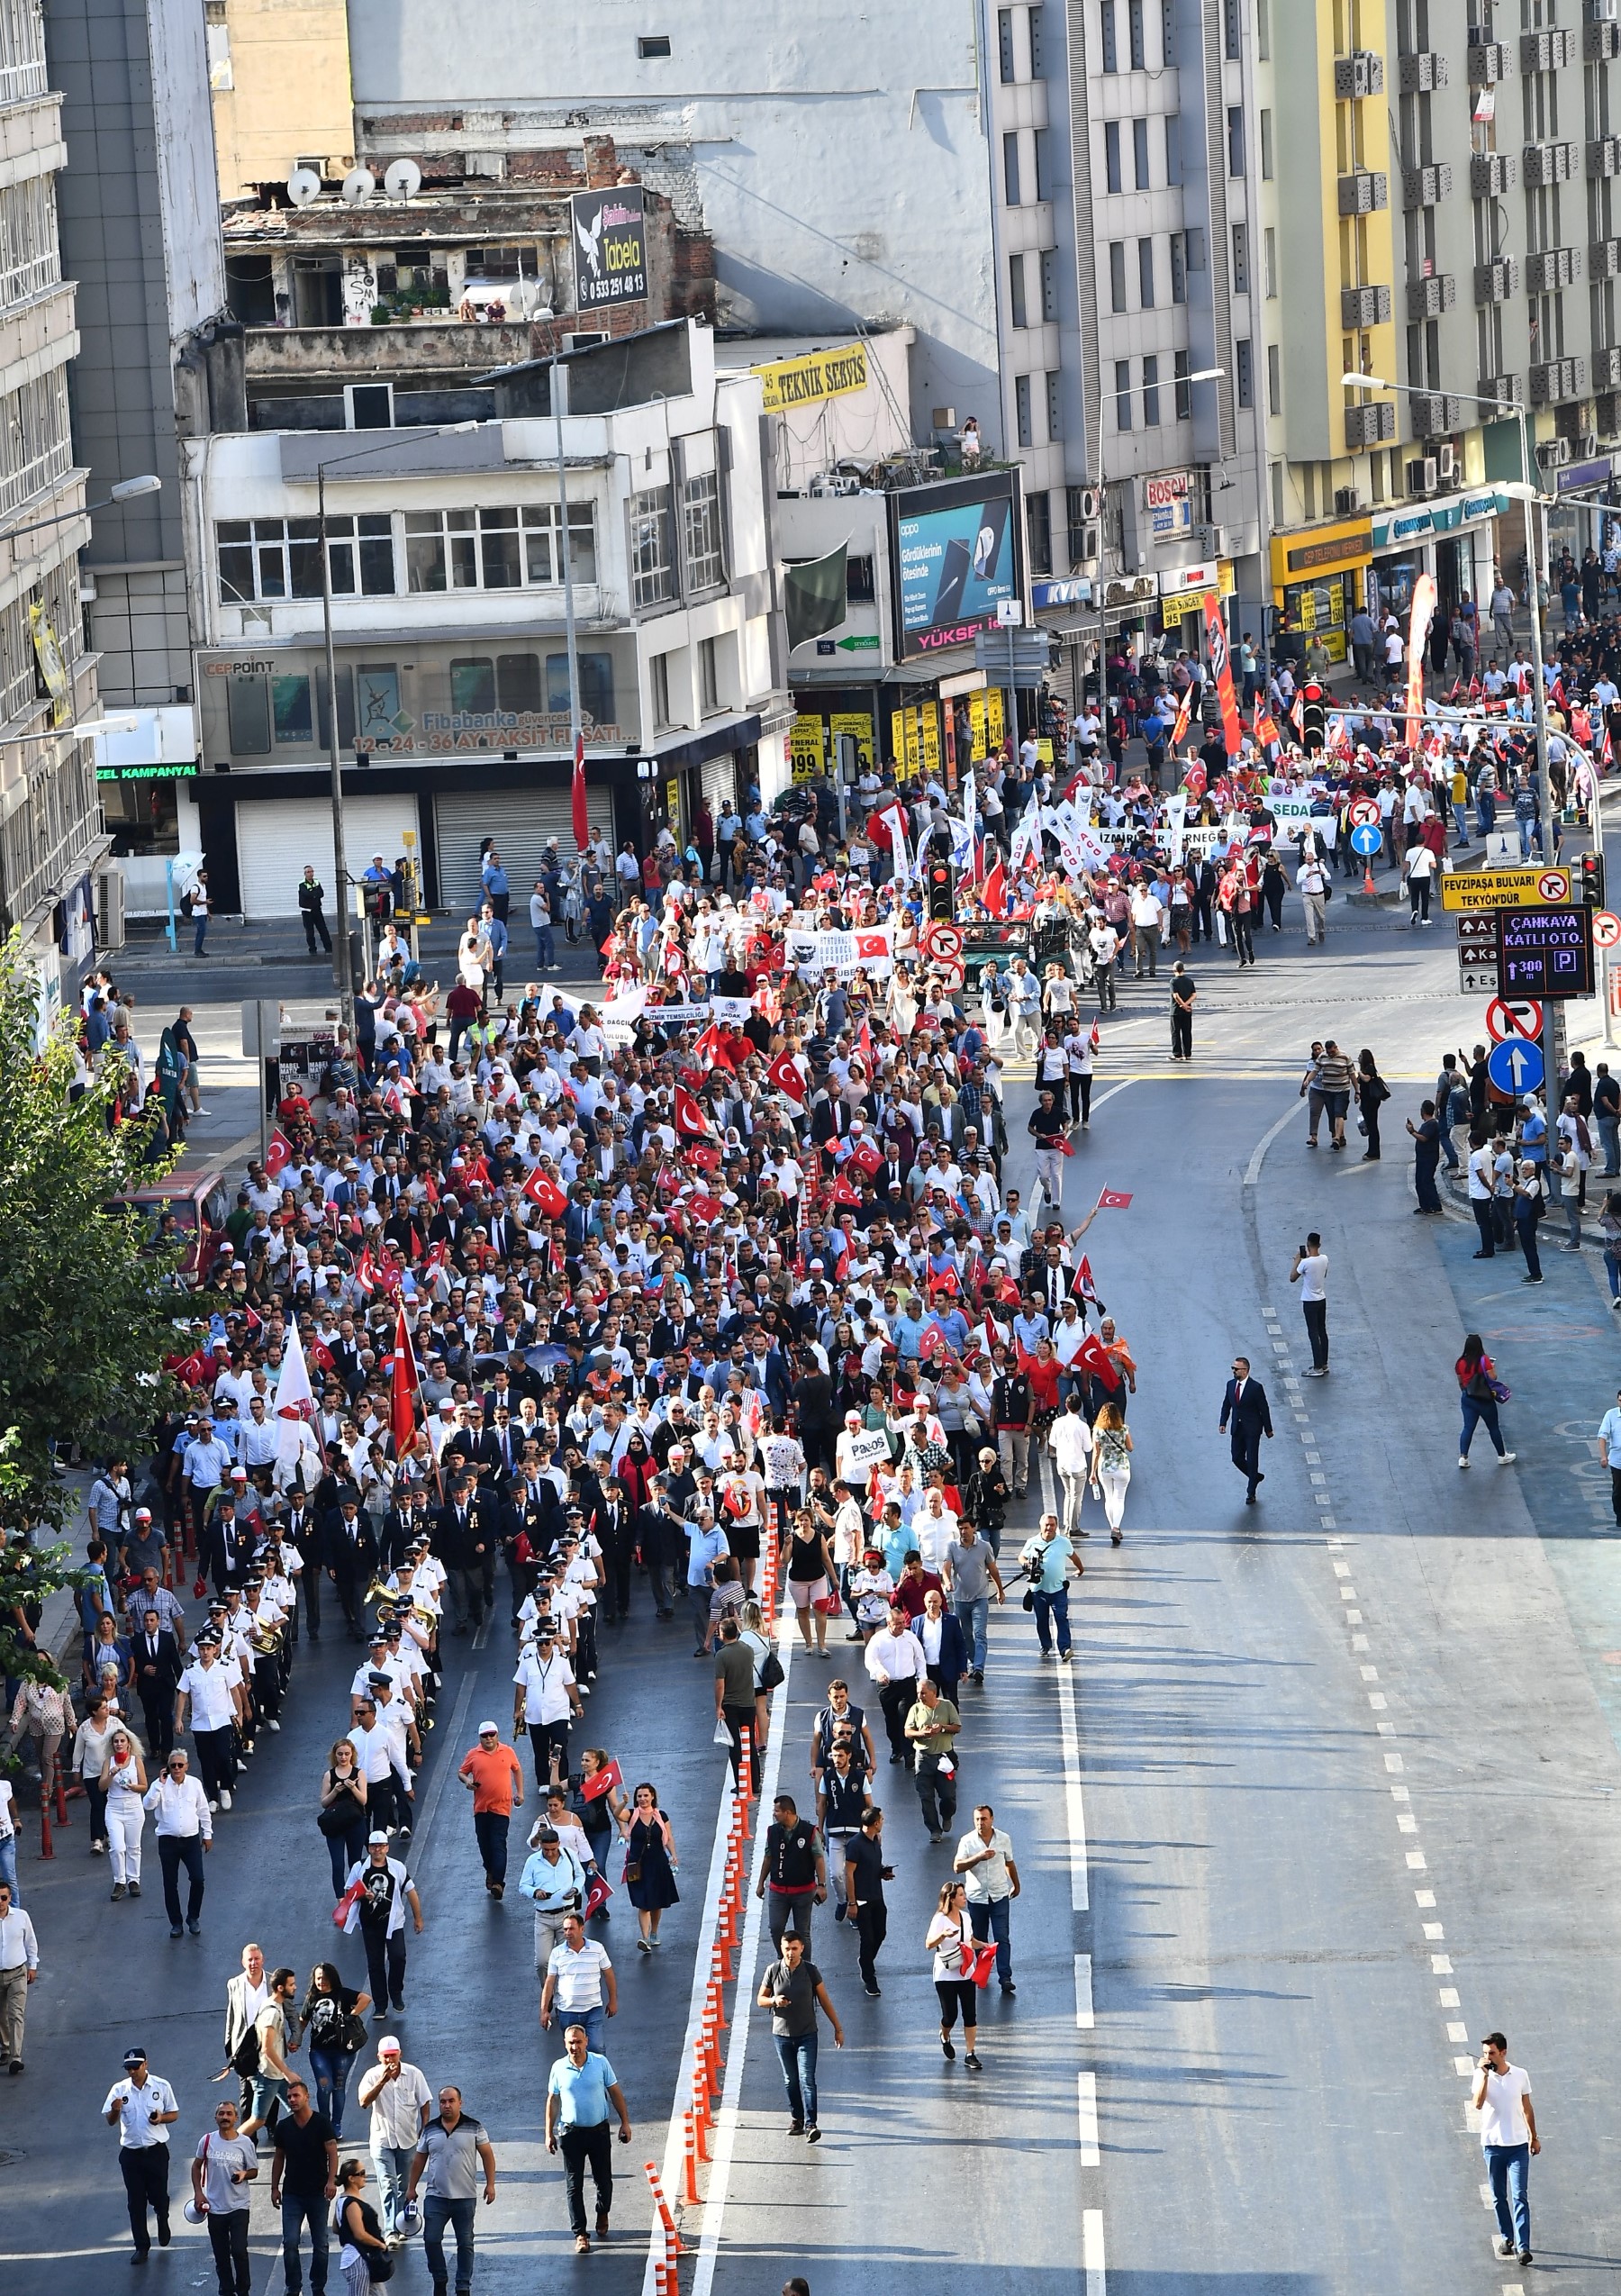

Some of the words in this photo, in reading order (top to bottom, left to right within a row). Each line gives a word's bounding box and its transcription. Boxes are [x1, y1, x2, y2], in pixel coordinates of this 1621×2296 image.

[603, 234, 640, 271] Tabela
[590, 282, 595, 300] 0
[596, 279, 610, 298] 533
[611, 277, 623, 295] 251
[624, 275, 634, 293] 48
[635, 273, 644, 291] 13
[765, 374, 774, 389] 45
[1149, 477, 1186, 504] BOSCH
[901, 523, 919, 538] oppo
[902, 543, 942, 564] Gördüklerinin
[903, 564, 929, 581] ötesinde
[1047, 582, 1080, 603] KVK
[424, 710, 516, 731] Fibabanka
[355, 735, 374, 753] 12
[392, 735, 413, 751] 24
[432, 733, 451, 749] 36
[457, 732, 481, 749] AY
[485, 728, 548, 747] TAKSİT
[554, 725, 638, 744] FISATI...
[96, 769, 118, 780] ZEL
[1444, 876, 1493, 891] FEVZİPAŞA
[1497, 876, 1535, 888] BULVARI
[1462, 892, 1519, 907] TEKYÖN'DÜR
[1511, 915, 1577, 932] ÇANKAYA
[1505, 934, 1545, 946] KATLI
[1550, 931, 1583, 945] OTO.
[1479, 949, 1497, 959] Ka
[1519, 960, 1543, 972] 300
[1480, 976, 1496, 985] Eş
[666, 1011, 703, 1020] TEMSİLCİLİĞİ
[830, 1780, 838, 1810] POLİS
